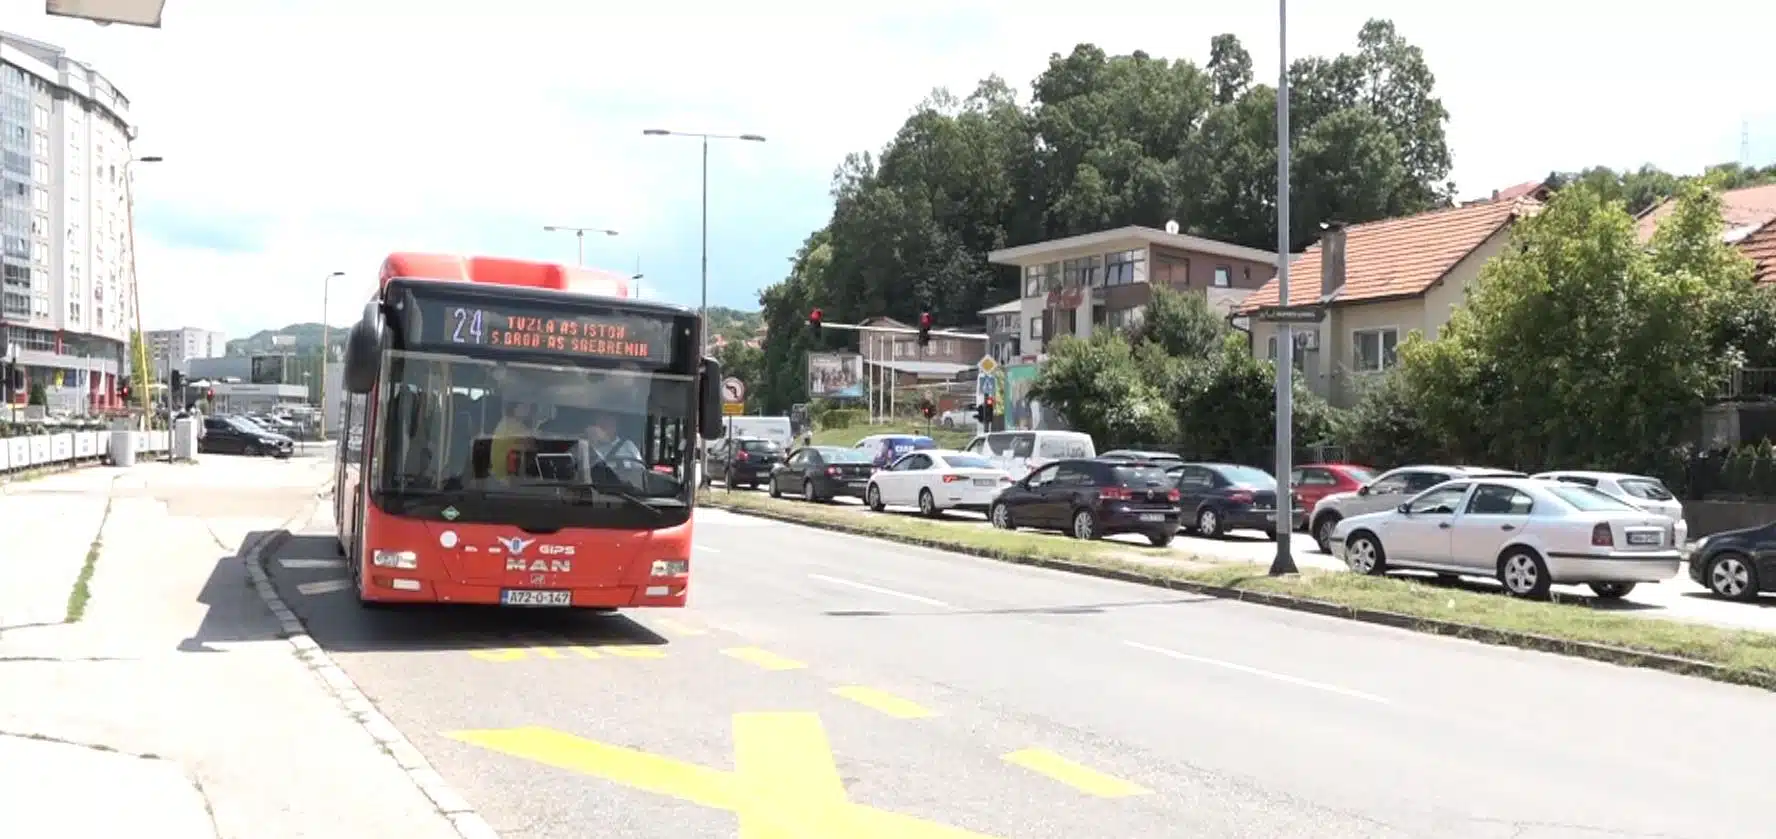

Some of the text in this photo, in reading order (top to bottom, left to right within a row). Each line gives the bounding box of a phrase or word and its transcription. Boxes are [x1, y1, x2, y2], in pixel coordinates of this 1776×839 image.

[452, 308, 483, 344] 24
[507, 315, 555, 333] TUZLA
[559, 319, 577, 337] AS
[506, 557, 571, 573] MAN
